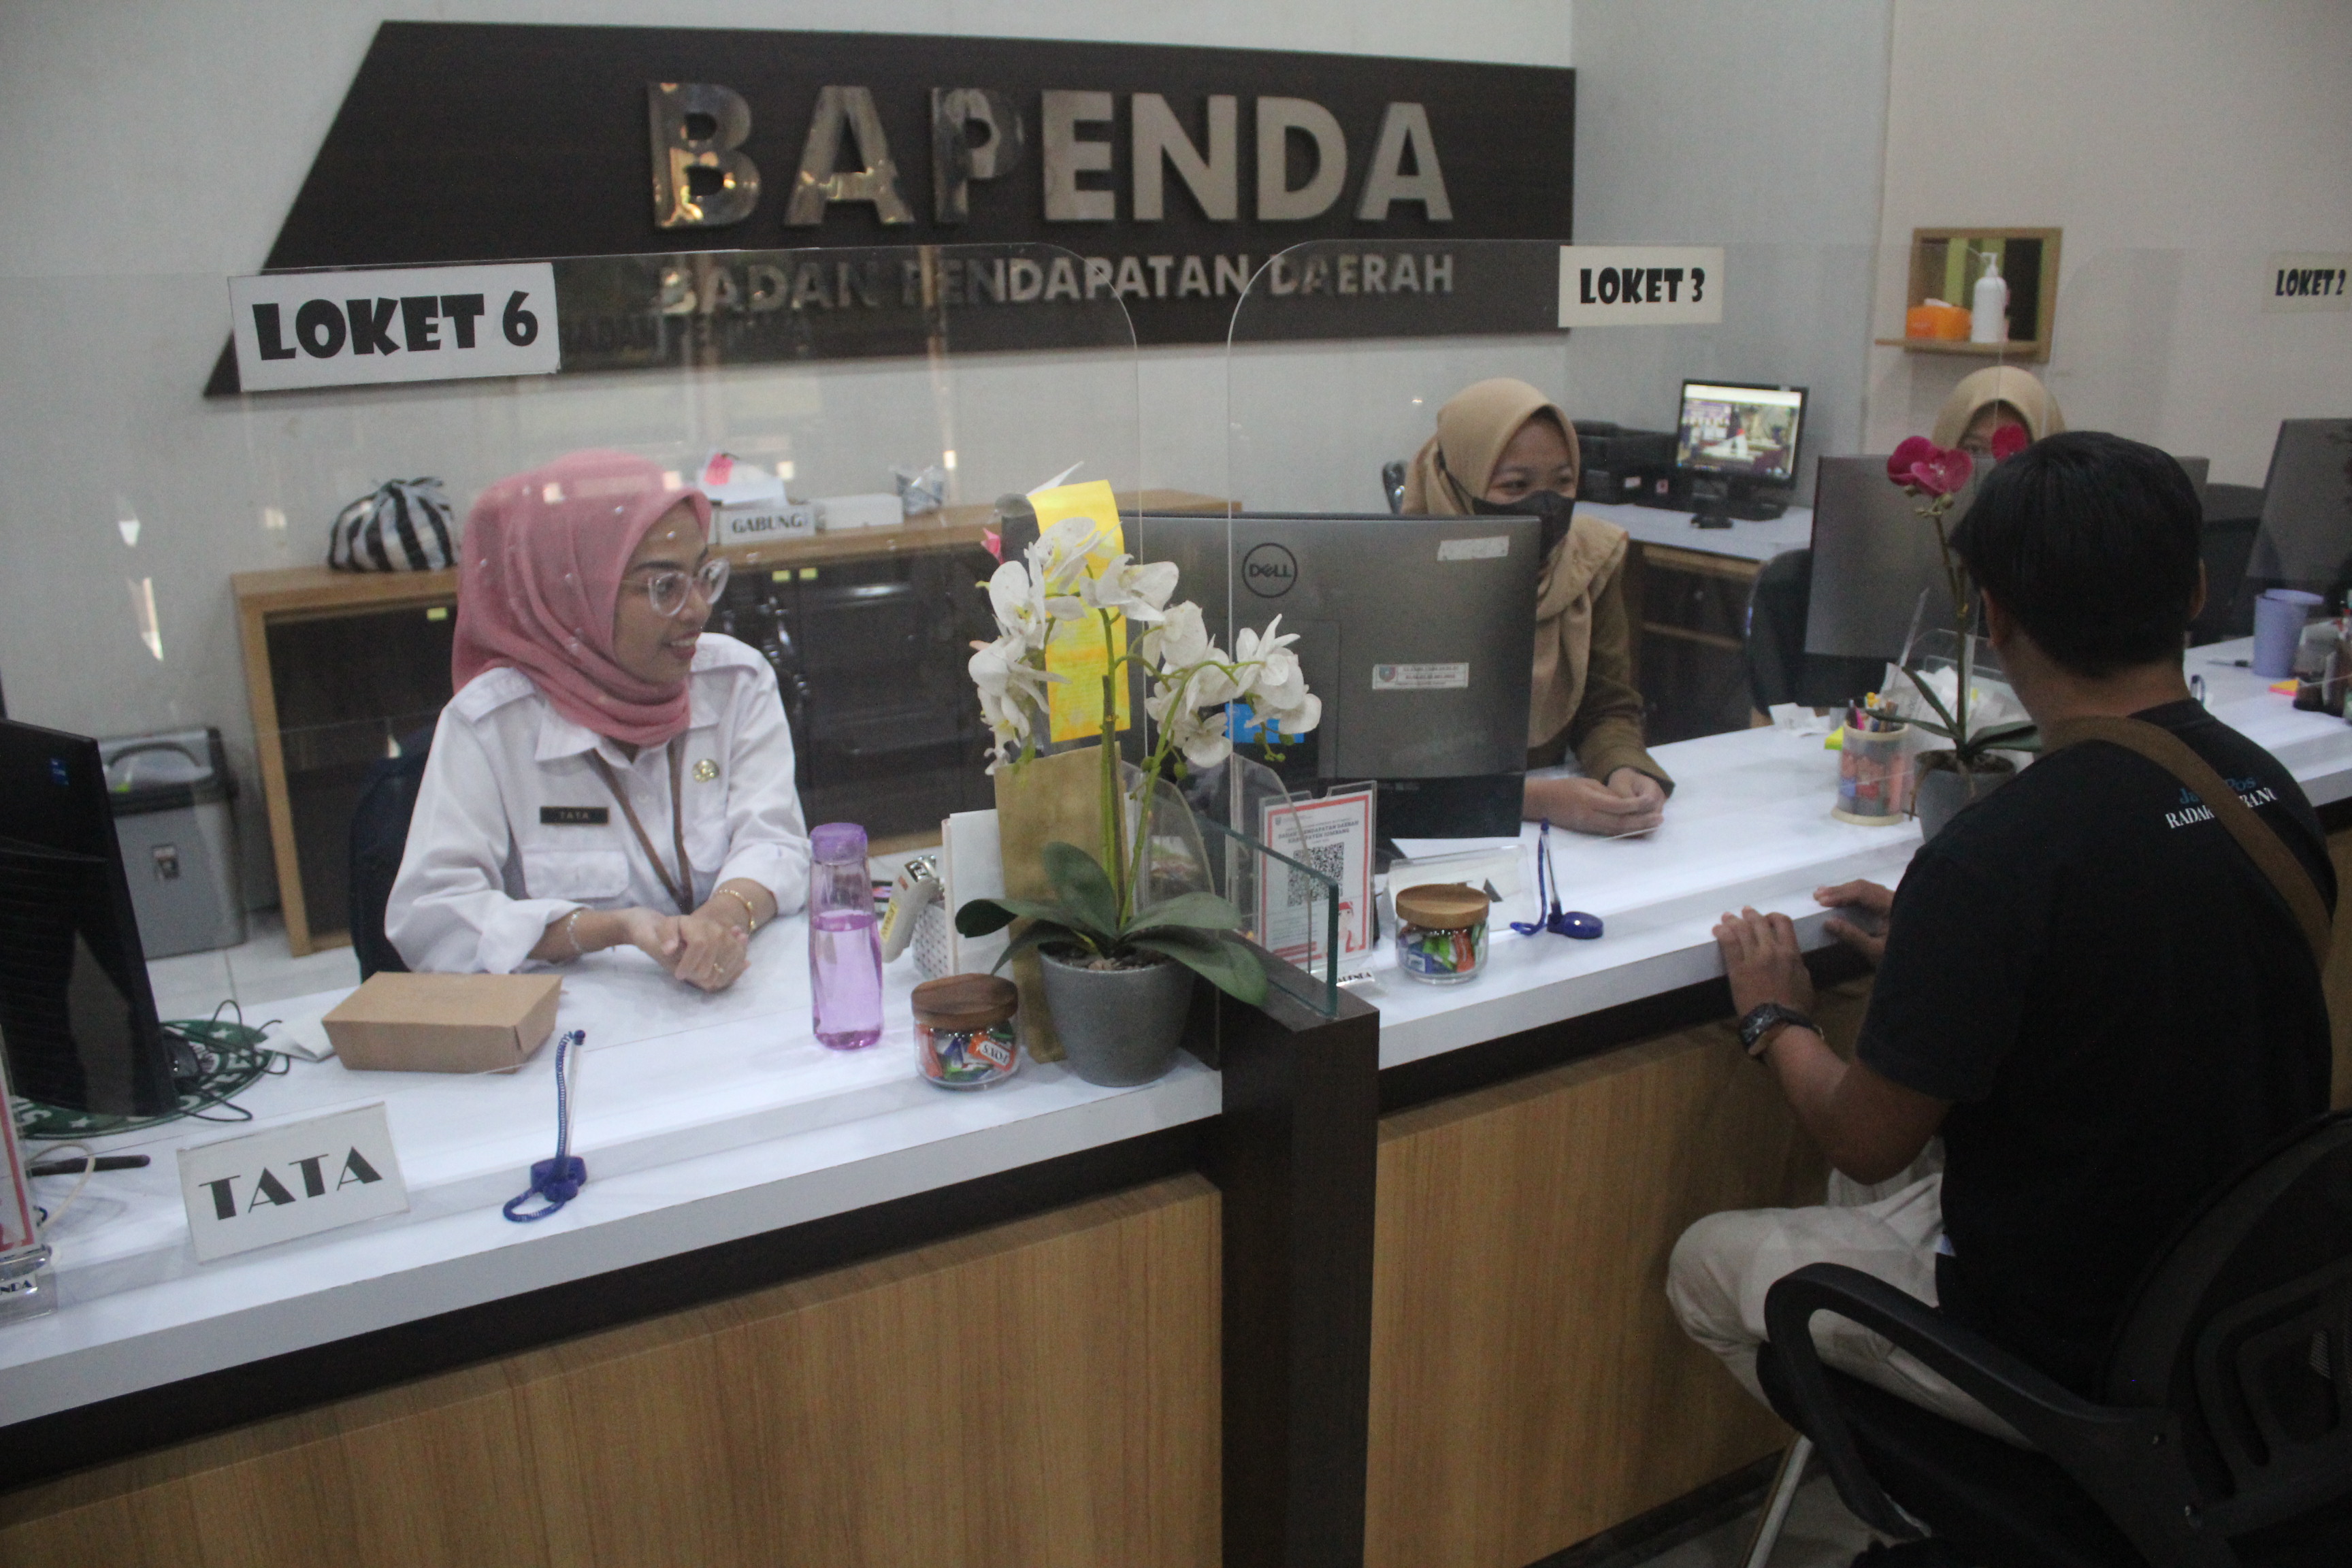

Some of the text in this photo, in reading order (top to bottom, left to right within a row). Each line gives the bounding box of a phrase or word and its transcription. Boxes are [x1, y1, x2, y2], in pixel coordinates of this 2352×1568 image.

[647, 81, 1454, 229] BAPENDA
[659, 264, 882, 316] BADAN
[1269, 252, 1454, 297] DAERAH
[1580, 267, 1705, 304] LOKET 3
[2275, 269, 2336, 296] LOKET
[251, 290, 539, 361] LOKET 6
[1249, 563, 1292, 578] DELL
[198, 1145, 383, 1221] TATA
